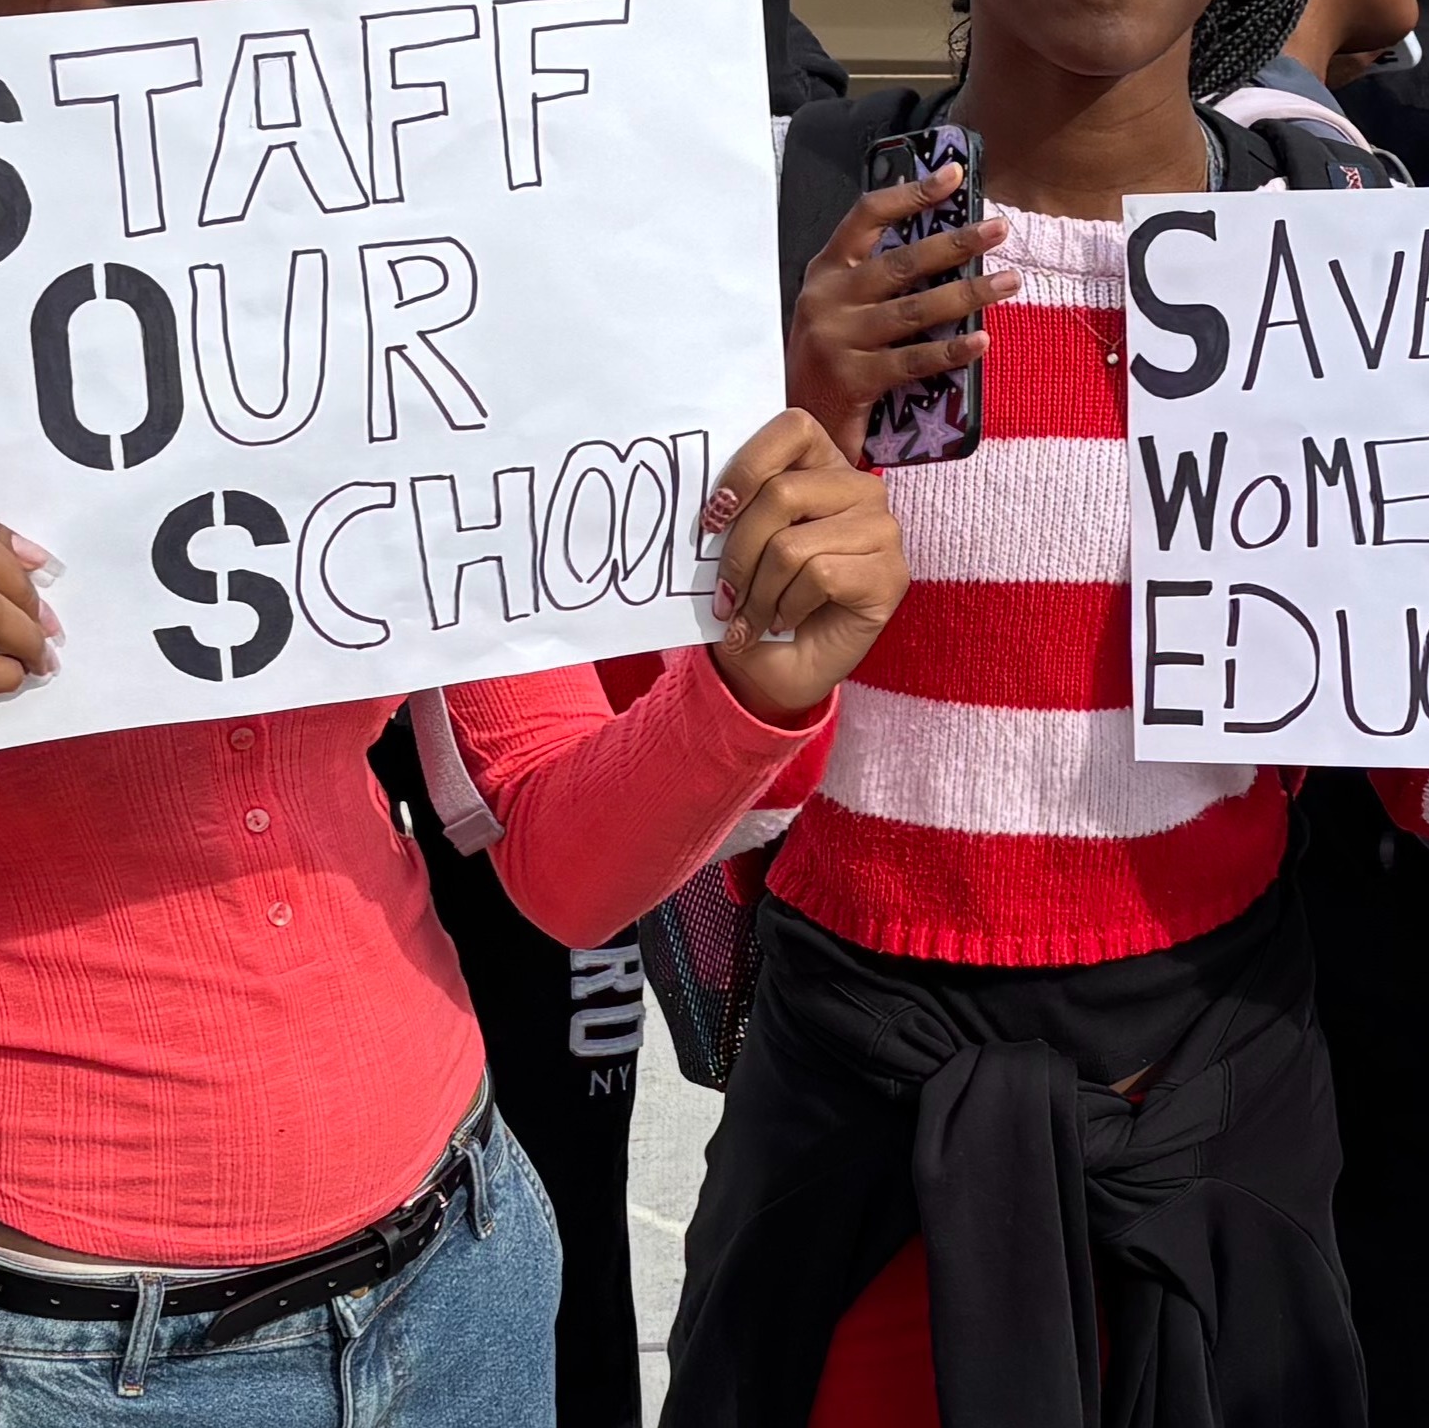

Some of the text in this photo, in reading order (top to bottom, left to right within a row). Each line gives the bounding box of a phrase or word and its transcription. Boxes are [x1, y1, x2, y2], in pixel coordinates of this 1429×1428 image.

[30, 236, 488, 472] OUR
[151, 430, 720, 683] SCHOOL
[589, 1063, 631, 1096] NY
